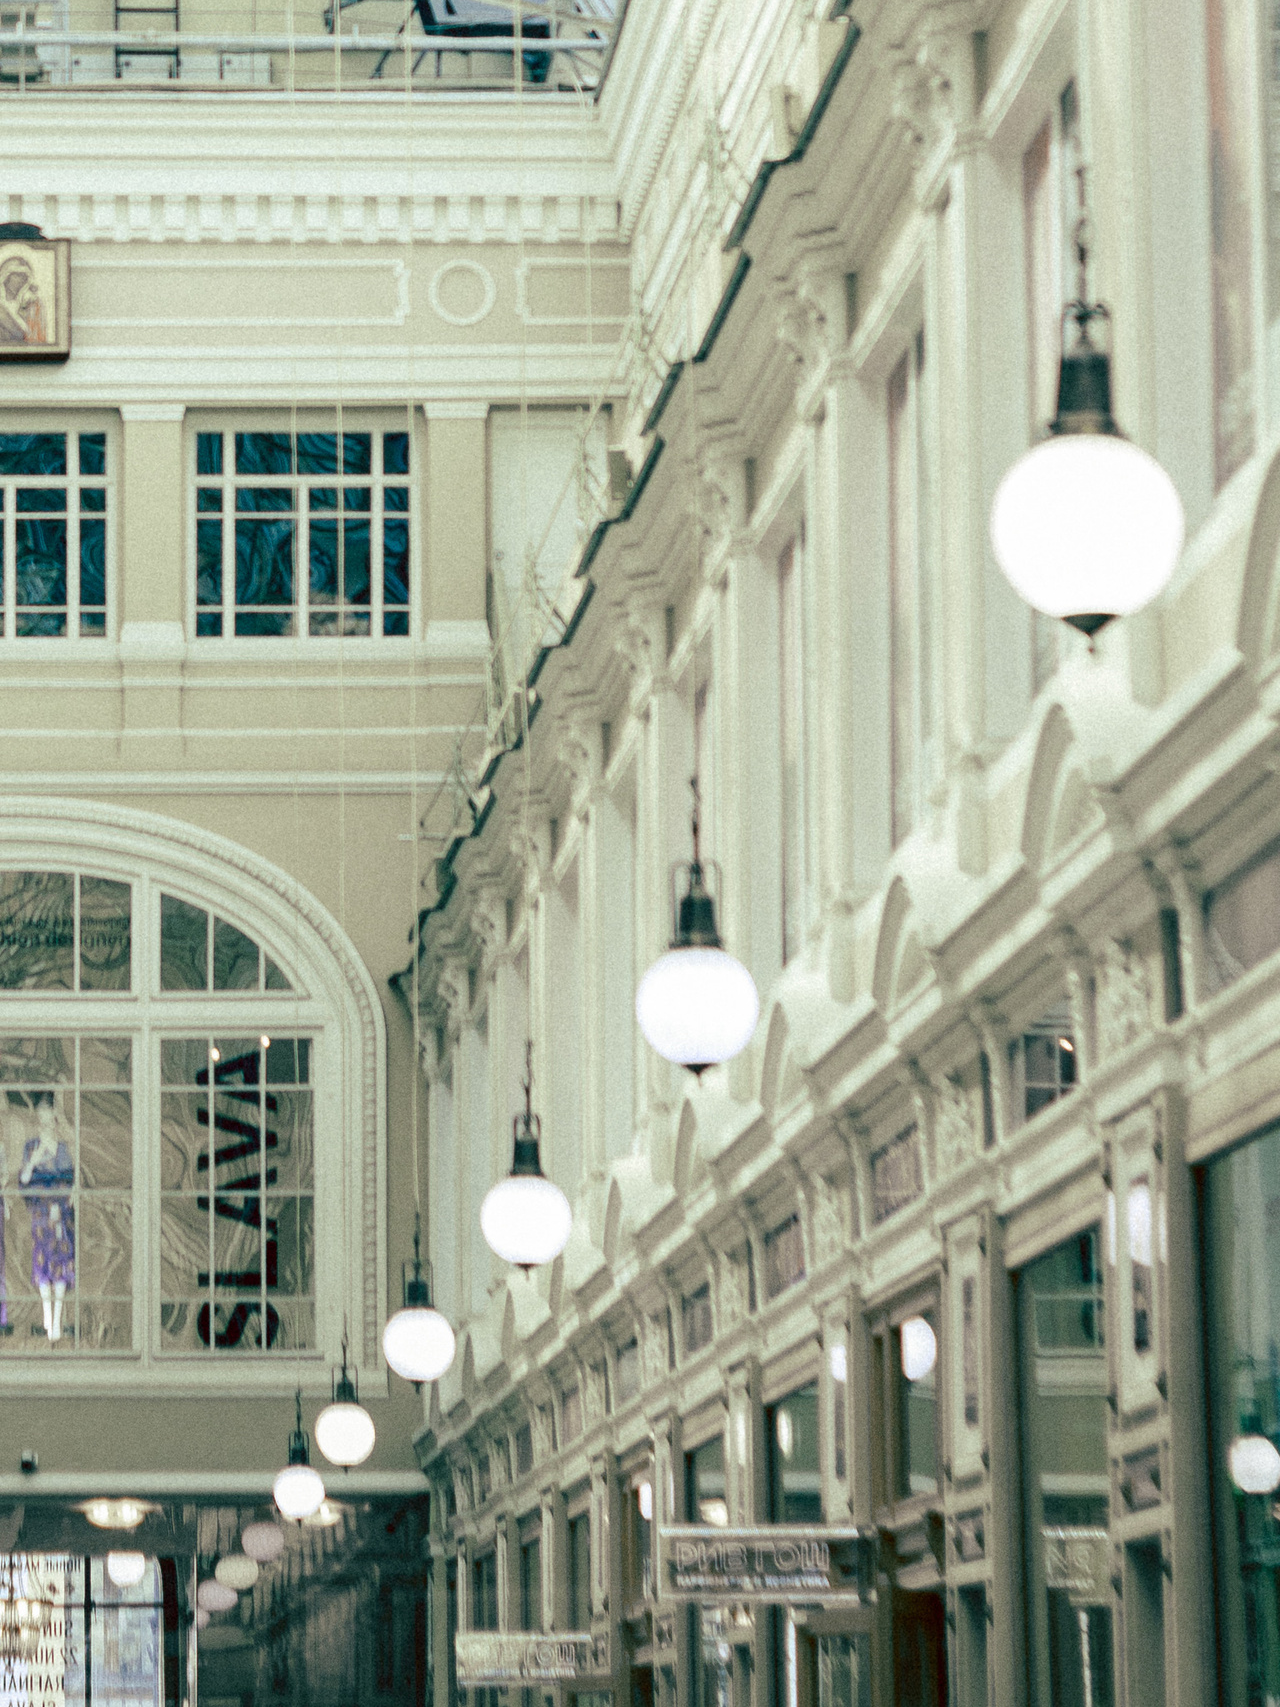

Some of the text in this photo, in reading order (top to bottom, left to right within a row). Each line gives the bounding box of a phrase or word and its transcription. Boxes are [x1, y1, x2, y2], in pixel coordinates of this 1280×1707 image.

[196, 1051, 279, 1349] SLAVA
[676, 1541, 830, 1574] РИВ ГОШ
